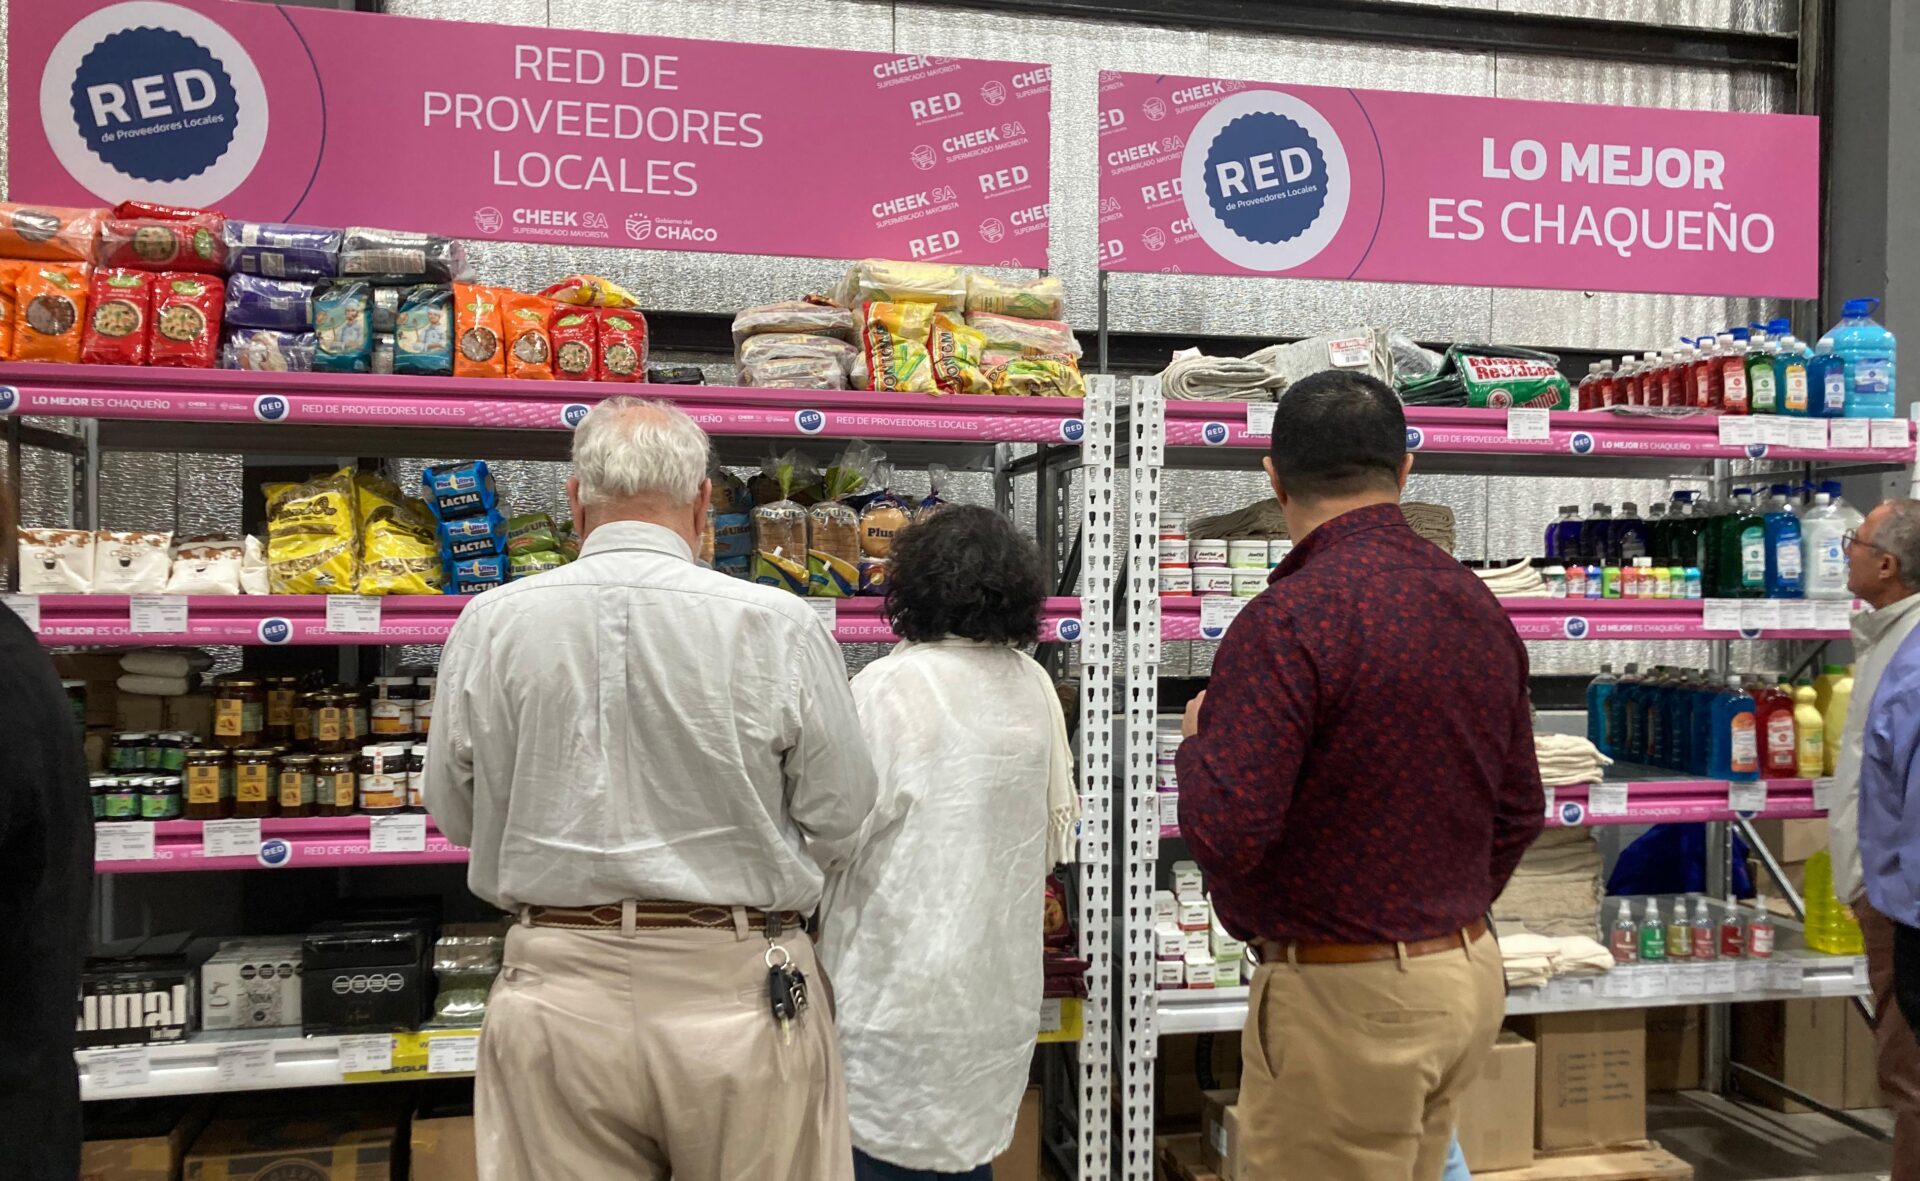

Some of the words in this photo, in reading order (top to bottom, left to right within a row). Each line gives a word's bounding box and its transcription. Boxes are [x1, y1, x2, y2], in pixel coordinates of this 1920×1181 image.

[514, 44, 605, 84] RED
[621, 52, 679, 90] DE
[873, 55, 932, 78] CHEEK
[876, 73, 926, 89] SUPERMERCADO
[927, 64, 961, 77] MAYORISTA
[87, 68, 217, 127] RED
[1172, 80, 1226, 105] CHEEK
[910, 92, 962, 119] RED
[424, 91, 764, 148] PROVEEDORES
[101, 132, 115, 143] de
[117, 120, 182, 141] Proveedores
[184, 113, 224, 129] Locales
[942, 127, 999, 152] CHEEK
[1001, 122, 1026, 138] SA
[946, 146, 994, 163] SUPERMERCADO
[995, 138, 1028, 152] MAYORISTA
[1108, 141, 1160, 166] CHEEK
[1162, 136, 1185, 152] SA
[1111, 159, 1156, 176] SUPERMERCADO
[1482, 137, 1548, 180] LO
[1560, 143, 1725, 190] MEJOR
[494, 150, 698, 197] LOCALES
[978, 166, 1029, 192] RED
[1216, 146, 1314, 198] RED
[872, 192, 930, 218] CHEEK
[932, 185, 958, 204] SA
[1226, 202, 1236, 212] de
[1238, 189, 1284, 208] Proveedores
[1286, 184, 1318, 198] Locales
[512, 208, 578, 226] CHEEK
[582, 212, 608, 228] SA
[655, 217, 682, 225] Gobierno
[876, 211, 925, 228] SUPERMERCADO
[926, 202, 960, 216] MAYORISTA
[512, 227, 568, 236] SUPERMERCADO
[570, 230, 608, 238] MAYORISTA
[655, 226, 718, 242] CHACO
[1428, 198, 1485, 240] ES
[1500, 202, 1774, 258] CHAQUEÑO
[909, 230, 960, 258] RED
[32, 396, 48, 405] LO
[50, 396, 89, 406] MEJOR
[92, 398, 105, 407] ES
[107, 398, 170, 410] CHAQUEÑO
[261, 402, 282, 412] RED
[302, 404, 324, 413] RED
[326, 405, 339, 414] DE
[342, 406, 418, 416] PROVEEDORES
[420, 407, 466, 416] LOCALES
[568, 410, 586, 419] RED
[801, 414, 818, 424] RED
[836, 416, 854, 424] RED
[857, 417, 869, 426] DE
[871, 417, 936, 428] PROVEEDORES
[938, 420, 978, 430] LOCALES
[1065, 424, 1082, 433] RED
[1207, 426, 1224, 436] RED
[1433, 434, 1448, 442] RED
[1450, 435, 1461, 443] DE
[1574, 438, 1590, 446] RED
[1614, 442, 1638, 450] MEJOR
[440, 493, 480, 508] LACTAL
[868, 528, 894, 538] Plus
[453, 540, 493, 553] LACTAL
[56, 626, 94, 636] MEJOR
[96, 627, 110, 635] ES
[264, 624, 286, 634] RED
[838, 626, 857, 634] RED
[859, 626, 870, 634] DE
[1062, 624, 1079, 634] RED
[304, 846, 326, 856] RED
[327, 846, 341, 854] DE
